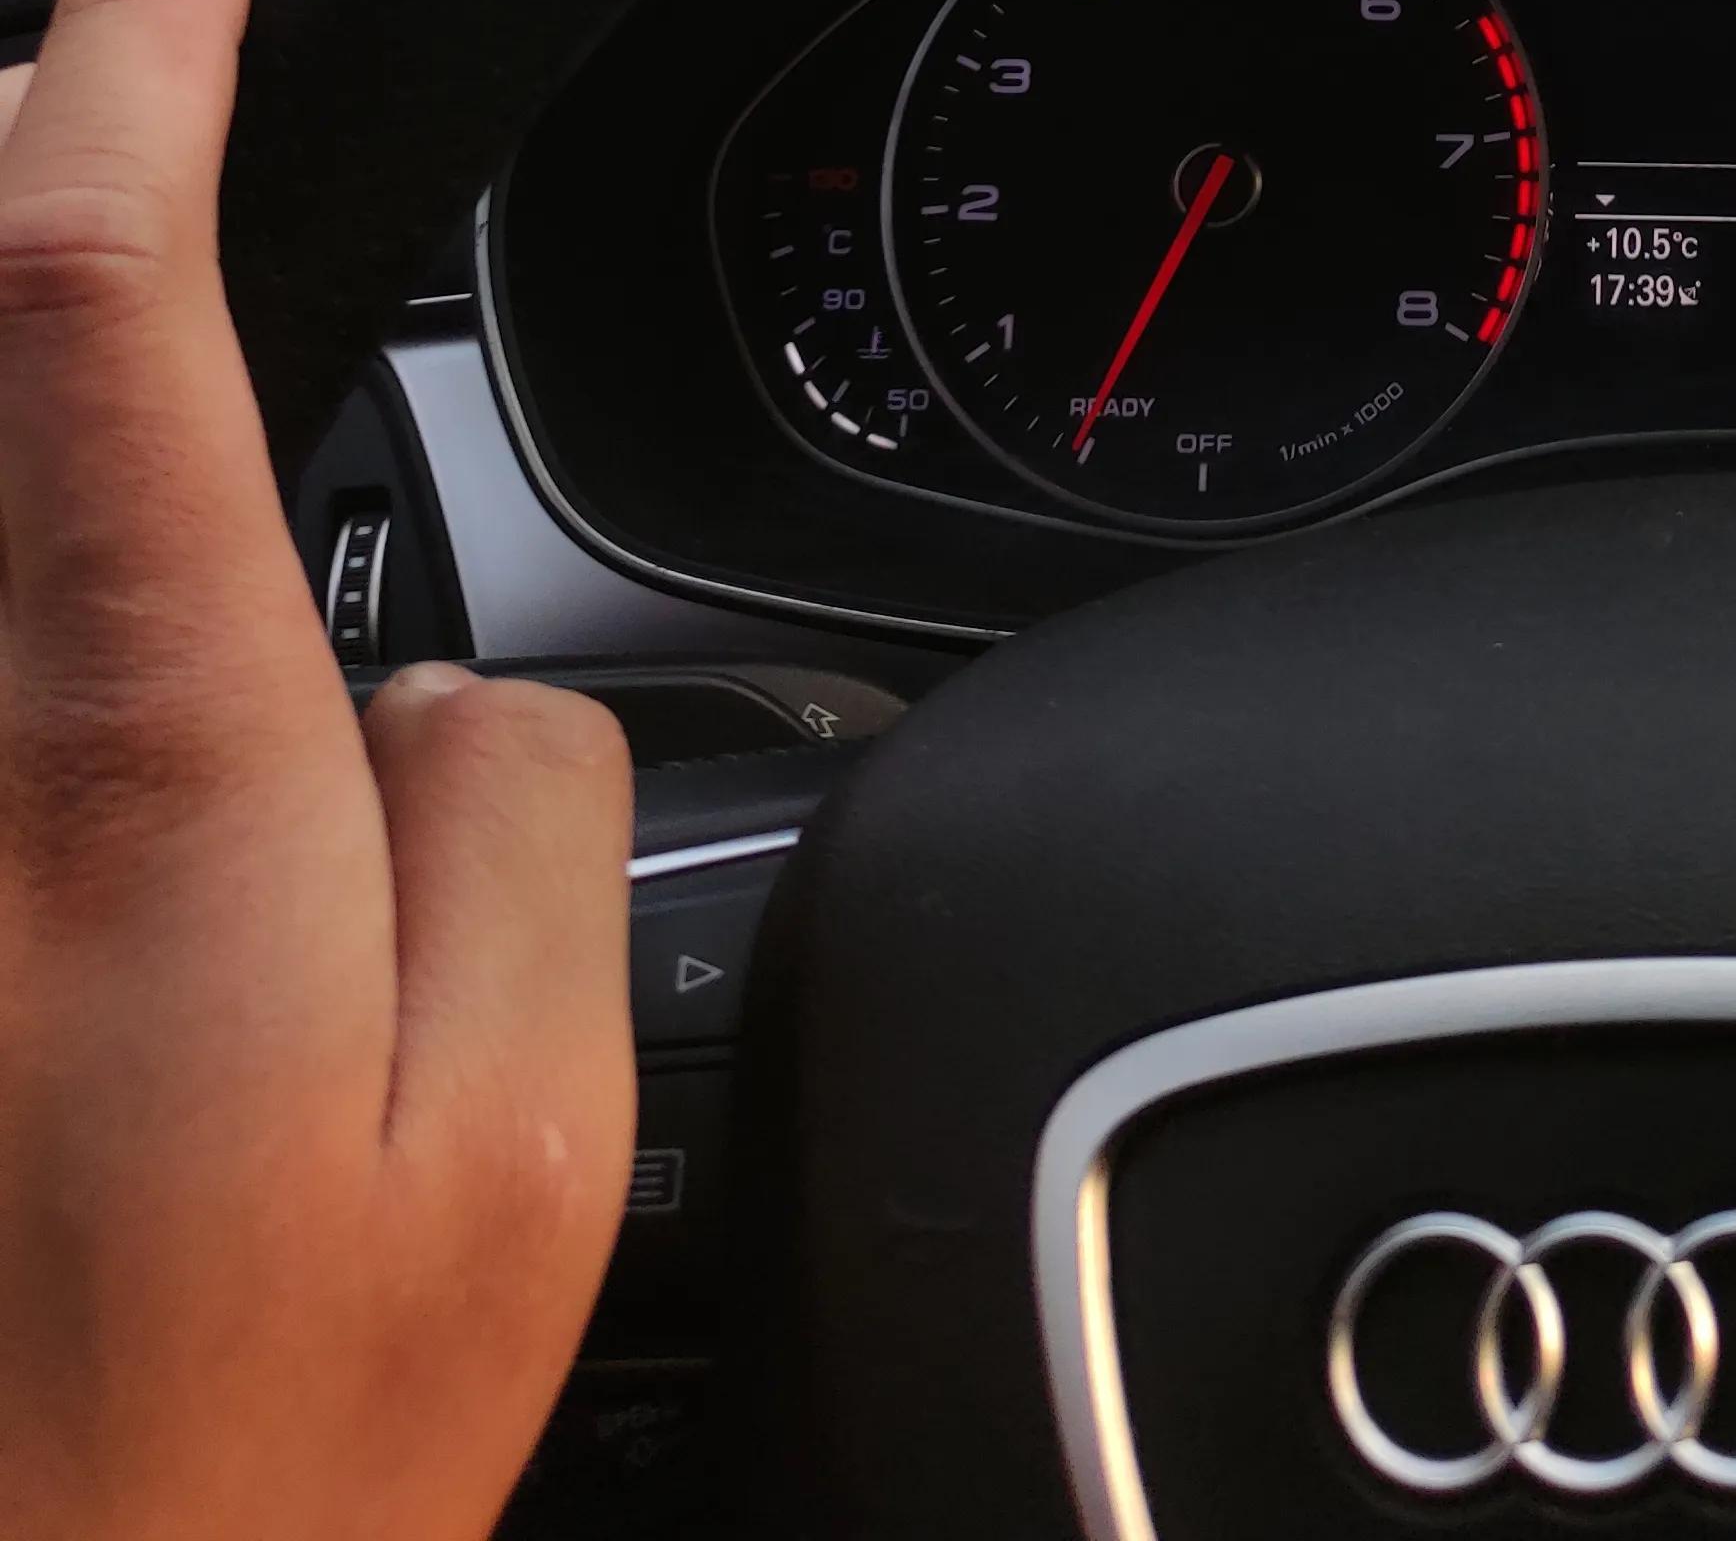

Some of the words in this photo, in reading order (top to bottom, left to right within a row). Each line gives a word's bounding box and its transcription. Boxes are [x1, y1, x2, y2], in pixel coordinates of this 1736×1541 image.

[990, 59, 1031, 93] 3
[1436, 134, 1474, 168] 7
[958, 185, 999, 220] 2
[824, 289, 864, 309] 90
[1591, 274, 1674, 307] 17:39
[1397, 291, 1438, 326] 8
[998, 314, 1013, 349] 1
[888, 389, 928, 410] 50
[1177, 434, 1232, 453] OFF
